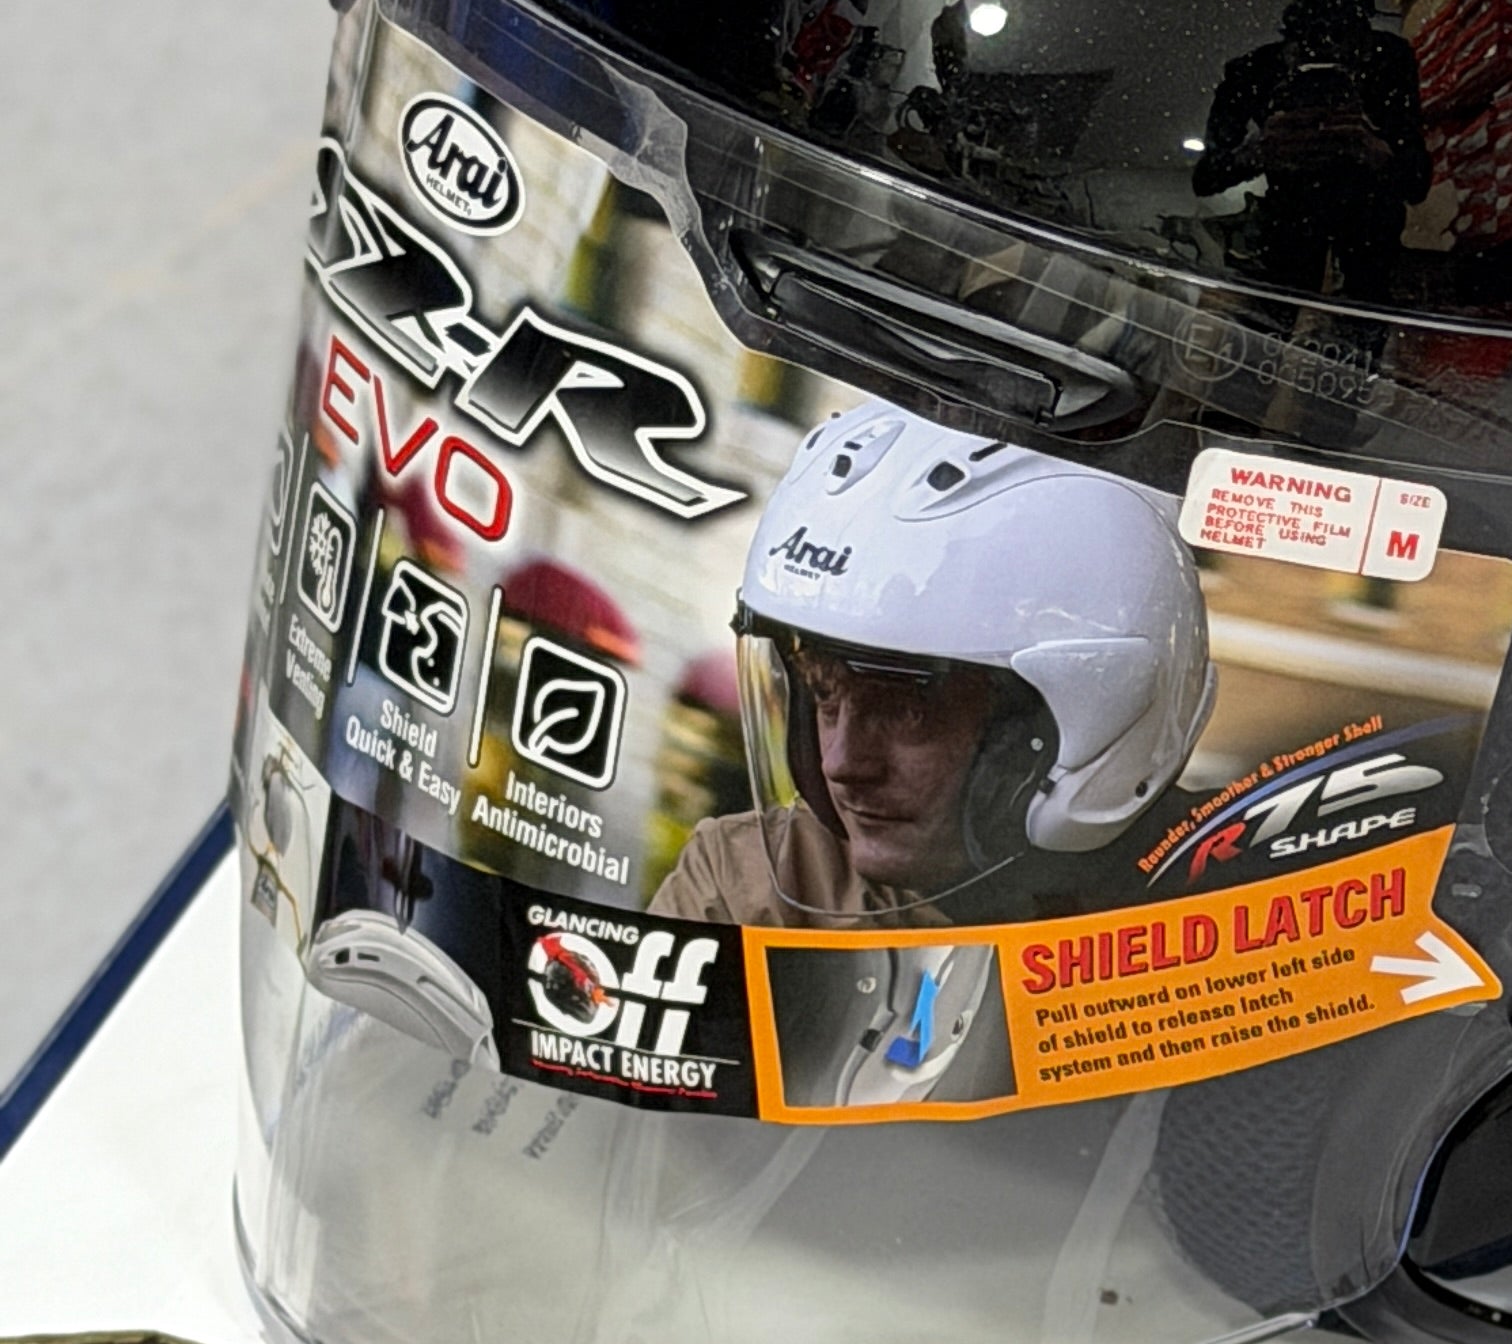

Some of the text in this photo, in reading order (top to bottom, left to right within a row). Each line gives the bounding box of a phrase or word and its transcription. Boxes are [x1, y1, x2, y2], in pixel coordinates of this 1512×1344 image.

[406, 113, 507, 209] Arai
[426, 173, 470, 213] HELMET
[318, 334, 514, 542] EVO
[1211, 488, 1323, 518] REMOVE THIS
[1230, 467, 1351, 503] WARNING
[1400, 493, 1431, 508] SIZE
[1200, 528, 1266, 549] HELMET
[1205, 516, 1326, 546] BEFORE USING
[1207, 502, 1351, 538] PROTECTIVE FILM
[1386, 530, 1420, 560] M
[769, 526, 852, 576] Arai
[289, 613, 332, 682] Extreme
[286, 648, 325, 721] Venting
[380, 699, 437, 758] Shield
[346, 715, 461, 816] Quick & Easy
[1137, 714, 1383, 874] Rounder, Smoother & Stronger Shell
[505, 771, 603, 840] Interiors
[1269, 807, 1416, 859] SHAPE
[471, 793, 630, 885] Antimicrobial
[527, 905, 640, 944] GLANCING
[1021, 868, 1406, 994] SHIELD LATCH
[1035, 948, 1356, 1028] Pull outward on lower left side
[1038, 988, 1294, 1054] of shield to release latch
[1039, 993, 1375, 1081] system and then raise the shield.
[531, 1030, 614, 1072] IMPACT
[621, 1050, 716, 1088] ENERGY
